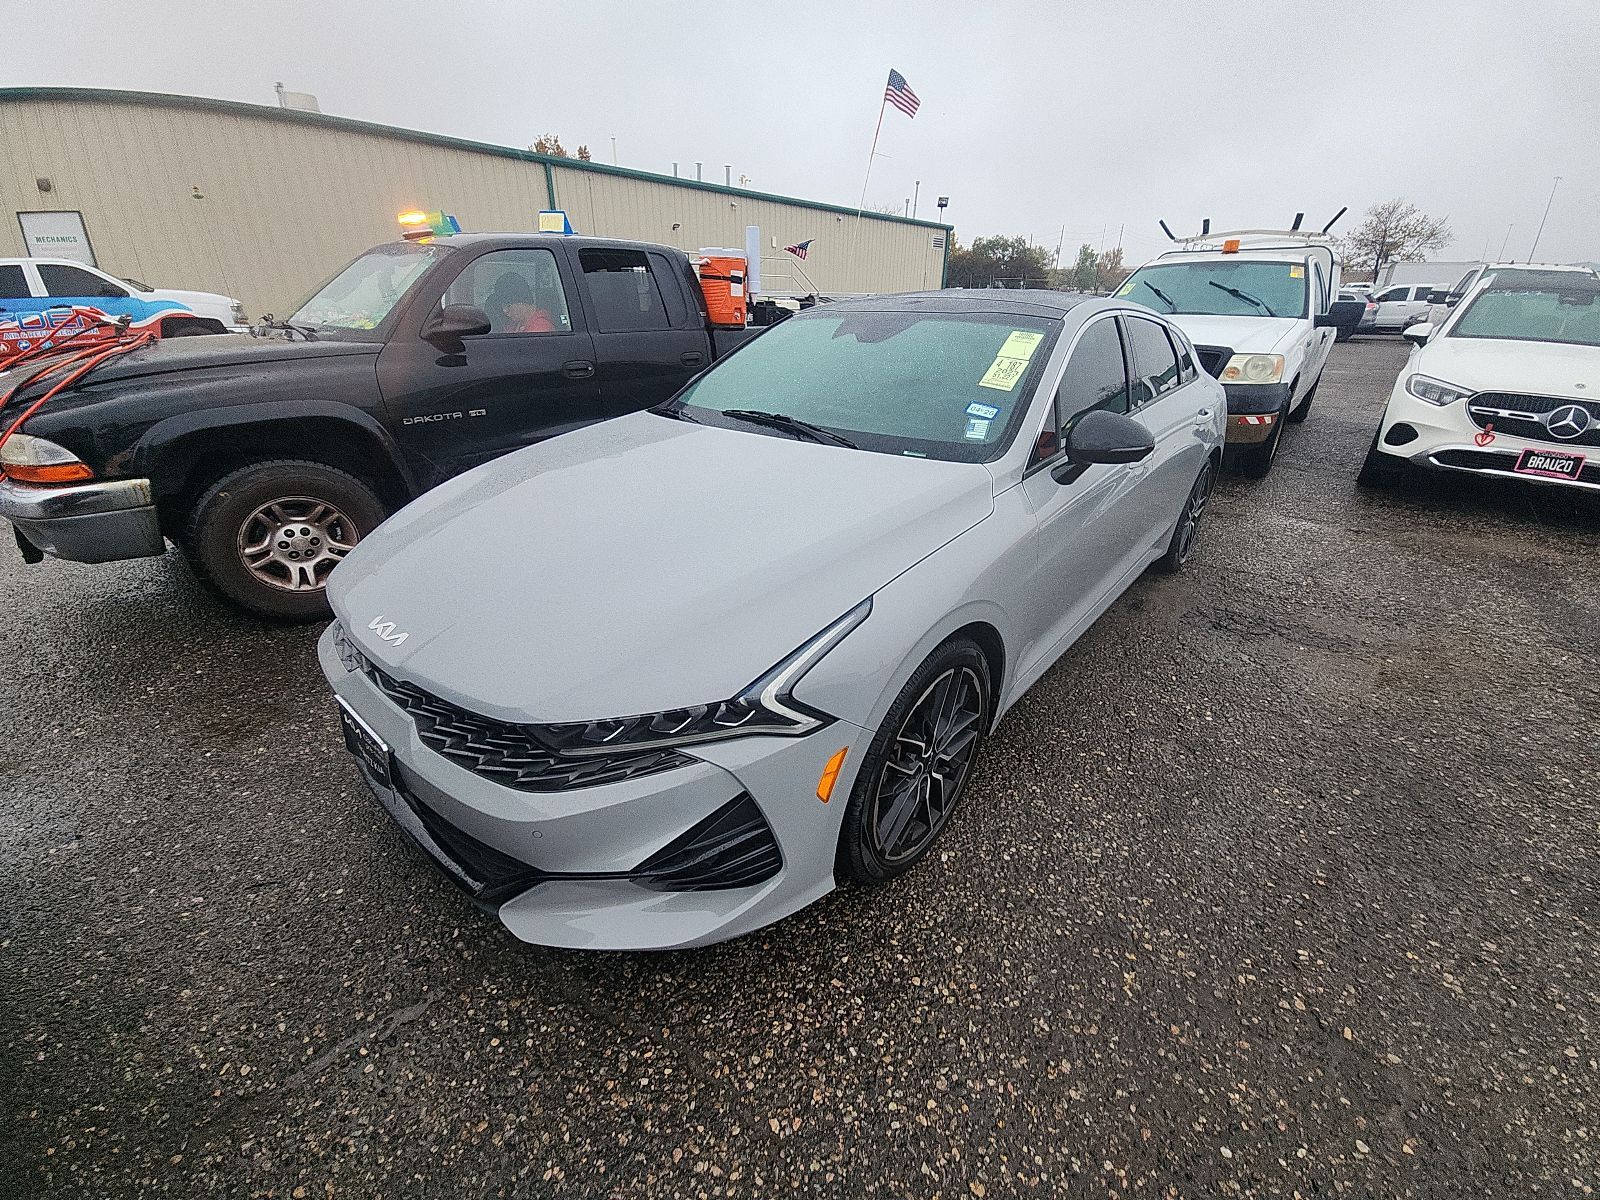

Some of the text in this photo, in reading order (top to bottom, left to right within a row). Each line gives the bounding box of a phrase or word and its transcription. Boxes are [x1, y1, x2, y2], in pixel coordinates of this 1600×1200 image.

[35, 236, 78, 244] MECHANICS
[403, 411, 463, 425] DAKOTA
[368, 615, 409, 647] KIA
